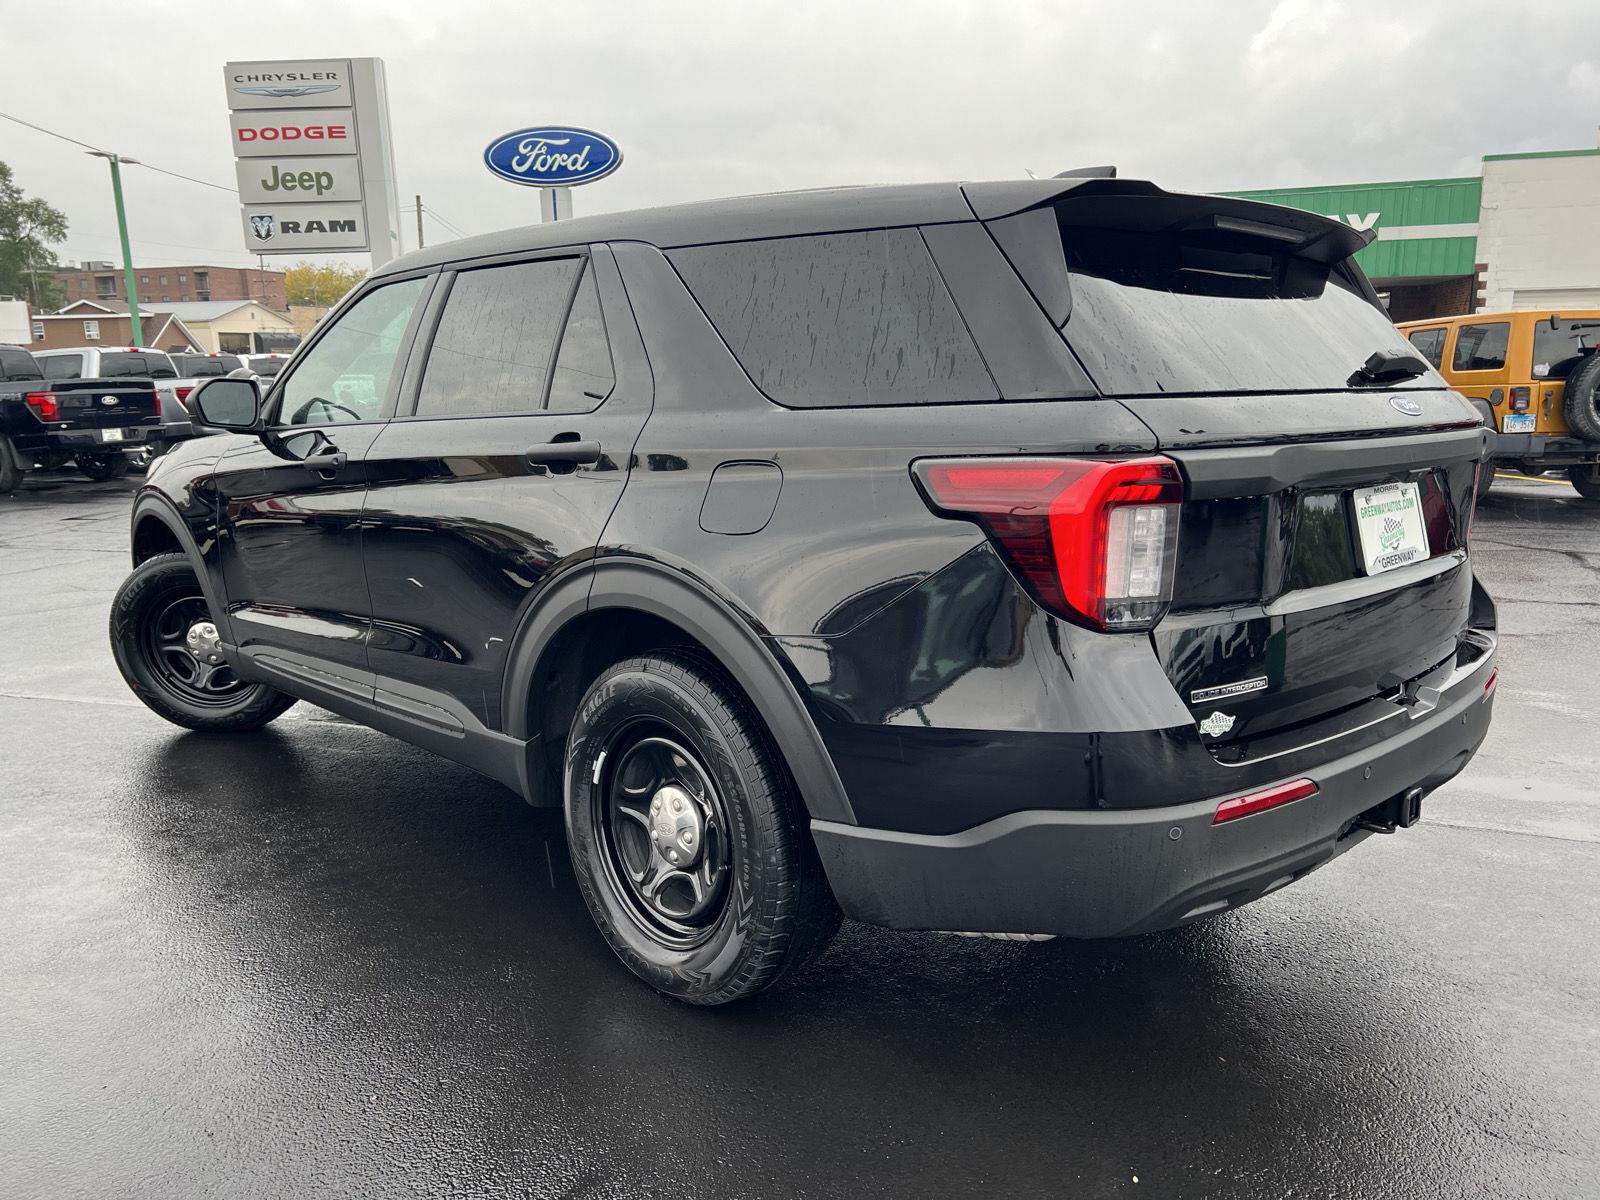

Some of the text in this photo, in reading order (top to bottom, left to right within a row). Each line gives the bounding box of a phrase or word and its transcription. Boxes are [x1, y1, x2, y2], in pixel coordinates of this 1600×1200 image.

[233, 72, 338, 83] CHRYSLER
[237, 125, 347, 142] DODGE
[511, 137, 591, 173] Ford
[261, 165, 334, 195] Jeep
[280, 219, 357, 234] RAM
[1374, 485, 1399, 493] MORRIS
[1360, 498, 1414, 518] GREENWAYAUTOS.COM
[1381, 550, 1415, 569] GREENWAY
[1193, 679, 1266, 701] POLICE INTERCEPTOR
[582, 685, 617, 724] EAGLE
